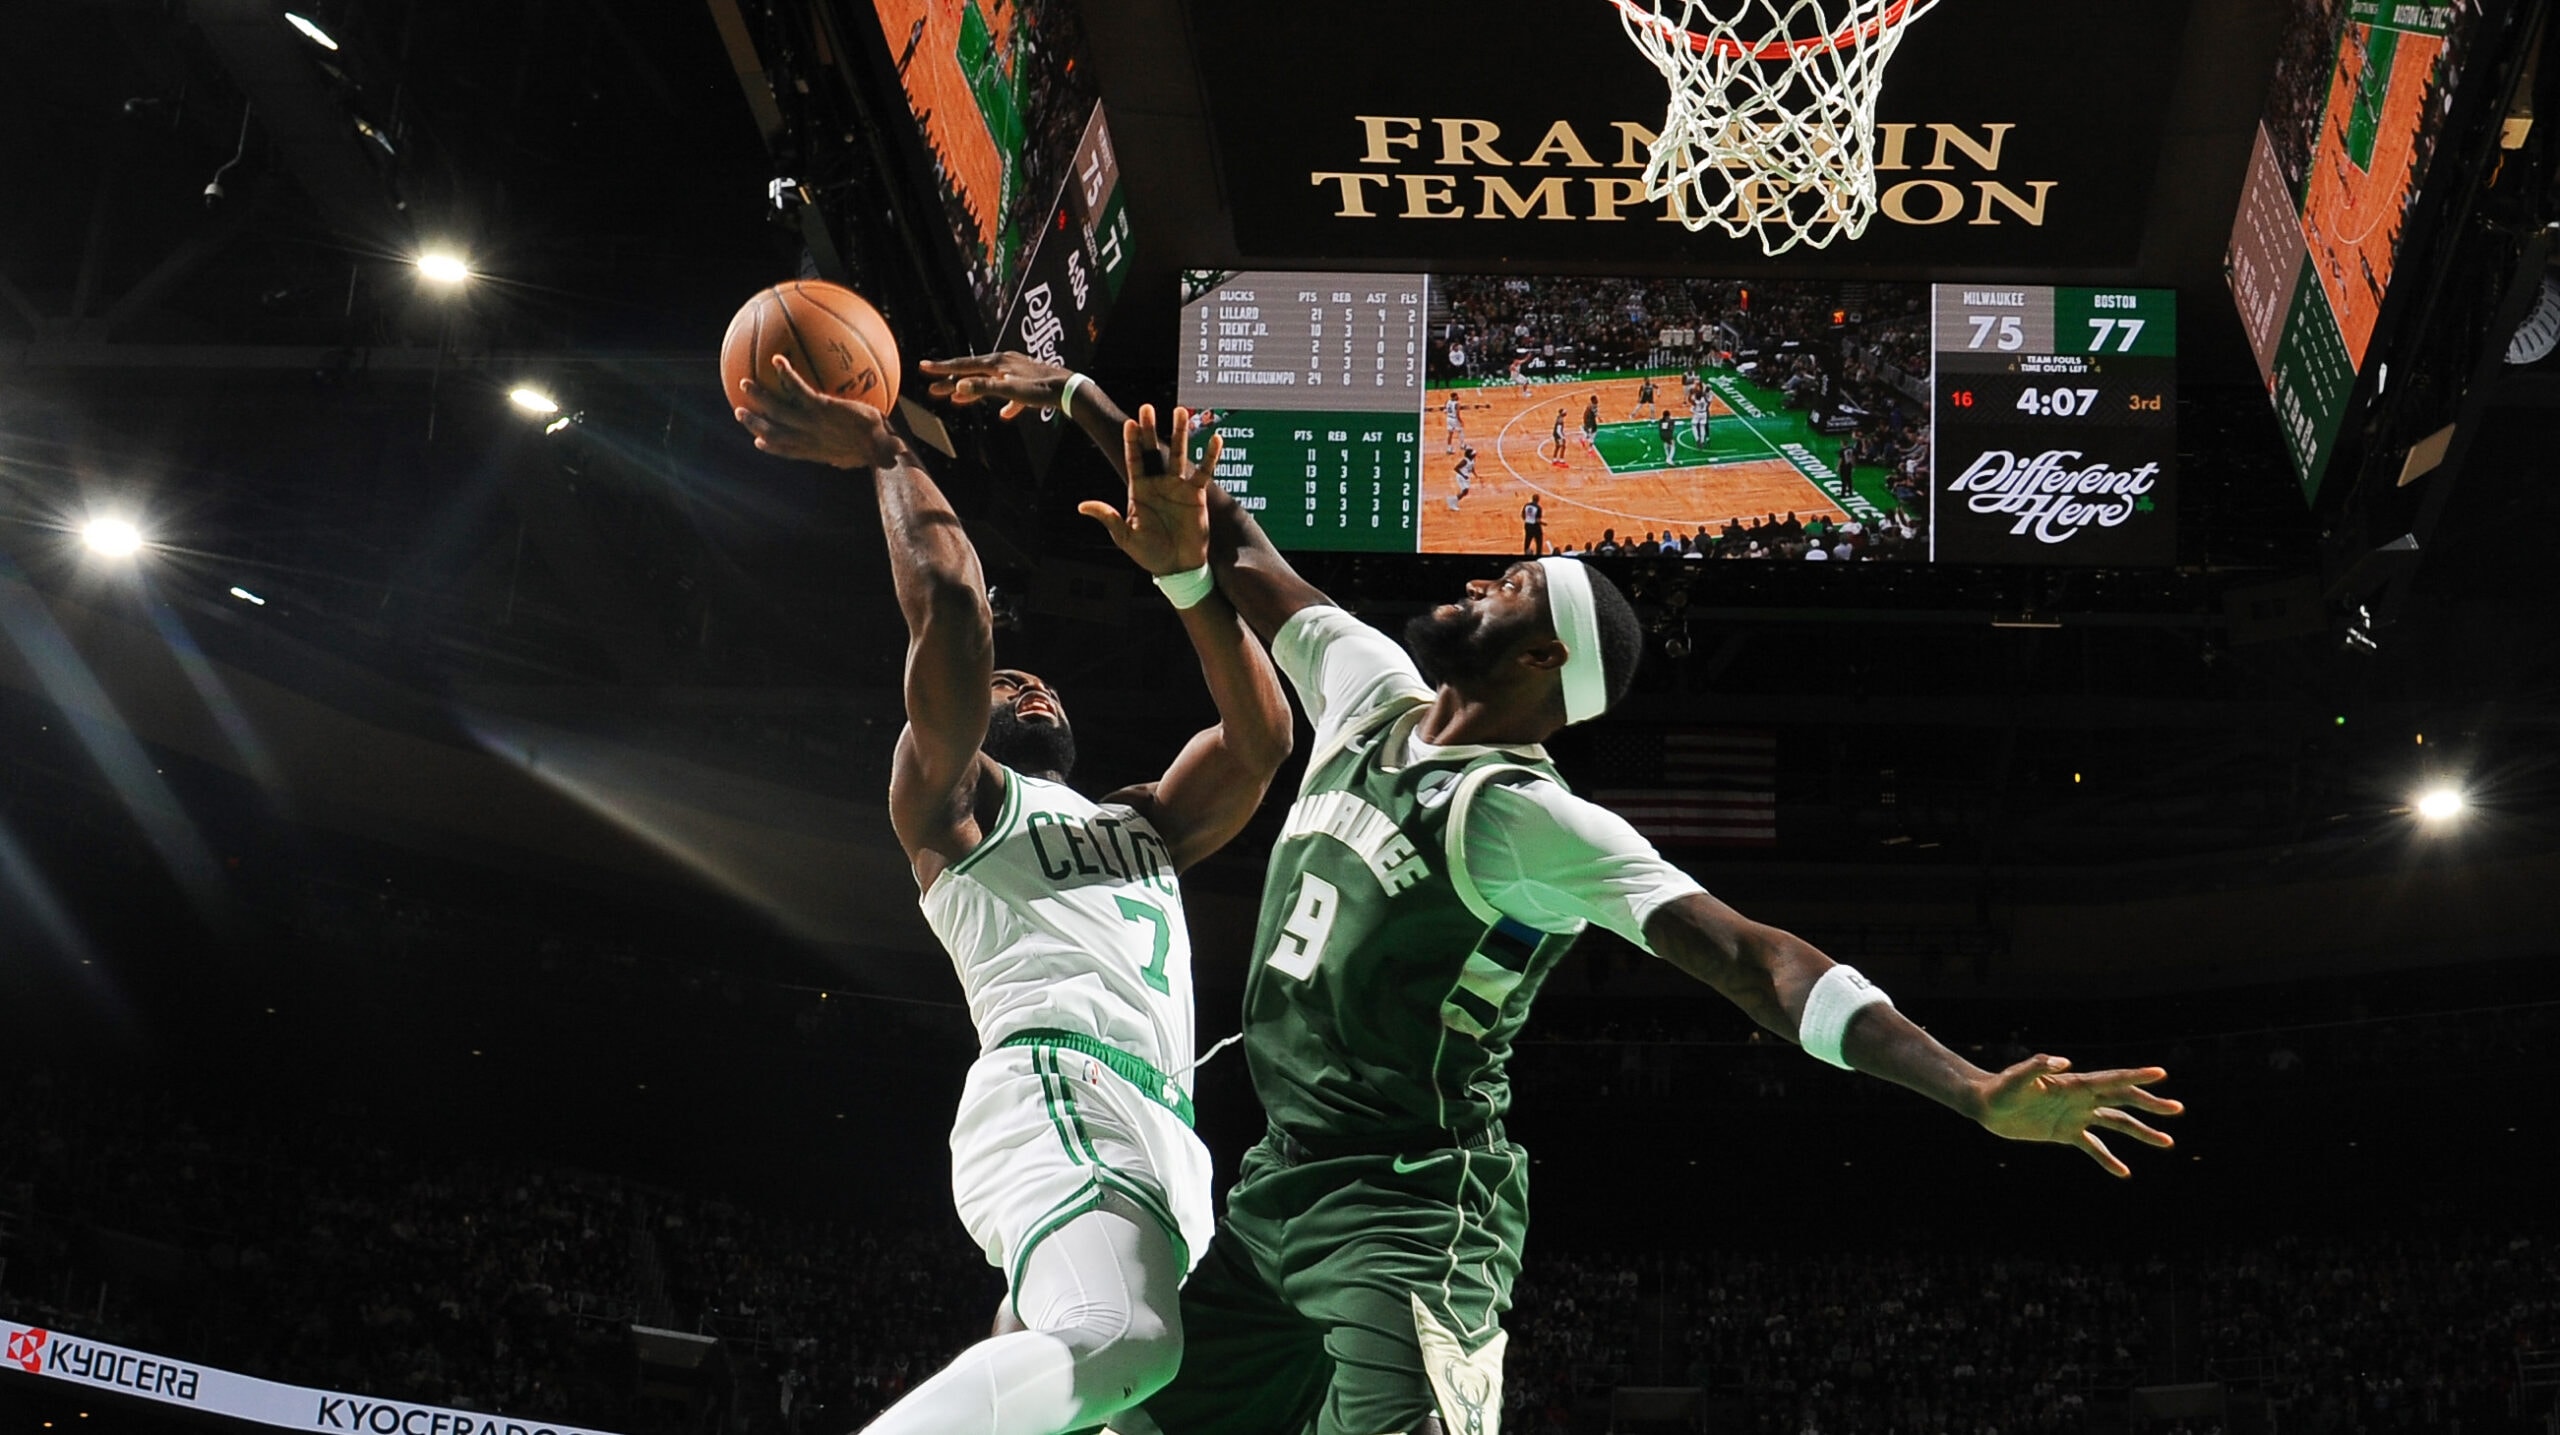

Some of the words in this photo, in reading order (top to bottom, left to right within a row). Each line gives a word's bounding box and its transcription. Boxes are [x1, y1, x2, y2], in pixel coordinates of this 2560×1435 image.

[1220, 291, 1254, 301] BUCKS
[1299, 292, 1317, 302] PTS
[1332, 293, 1351, 303] REB
[1367, 293, 1387, 303] AST
[1401, 294, 1417, 304] FLS
[1963, 292, 2024, 306] MILWAUKEE
[2094, 295, 2136, 308] BOSTON
[1202, 306, 1208, 319] 0
[1220, 307, 1259, 319] LILLARD
[1311, 308, 1322, 321] 21
[1345, 309, 1352, 321] 5
[1408, 310, 1415, 322] 2
[1201, 322, 1207, 335] 5
[1219, 322, 1250, 335] TRENT
[1252, 323, 1269, 335] JR.
[1345, 325, 1351, 337] 3
[1379, 325, 1384, 338] 1
[1409, 326, 1413, 338] 1
[1968, 316, 2023, 350] 75
[2088, 319, 2145, 351] 77
[1200, 338, 1207, 351] 9
[1218, 339, 1254, 351] PORTIS
[1312, 340, 1319, 353] 2
[1344, 340, 1351, 353] 5
[1377, 341, 1384, 354] 0
[1407, 341, 1414, 354] 0
[1198, 354, 1208, 367] 12
[1218, 354, 1253, 367] PRINCE
[1311, 356, 1318, 369] 0
[1343, 356, 1350, 369] 3
[1376, 357, 1384, 370] 0
[1407, 357, 1414, 370] 3
[2021, 364, 2041, 372] TIME
[2069, 365, 2088, 373] LEFT
[1196, 370, 1209, 383] 34
[1217, 370, 1295, 384] ANTETOKOUNMPO
[1308, 372, 1322, 385] 24
[1376, 374, 1384, 386] 6
[1406, 374, 1414, 386] 2
[1952, 391, 1974, 407] 16
[2017, 387, 2099, 416] 4:07
[2129, 395, 2161, 410] 3rd
[1215, 427, 1255, 438] CELTICS
[1294, 430, 1313, 441] PTS
[1328, 431, 1347, 441] REB
[1362, 432, 1383, 442] AST
[1397, 432, 1414, 443] FLS
[1220, 448, 1247, 461] ATUM
[1308, 448, 1316, 461] 11
[1341, 449, 1348, 462] 4
[1375, 449, 1380, 463] 1
[1404, 450, 1411, 463] 3
[1213, 464, 1254, 477] HOLIDAY
[1306, 465, 1317, 478] 13
[1341, 465, 1348, 478] 3
[1373, 466, 1380, 479] 3
[1405, 466, 1409, 480] 1
[1948, 450, 2160, 508] Different
[1306, 481, 1317, 494] 19
[1340, 482, 1347, 495] 6
[1373, 482, 1380, 495] 3
[1403, 483, 1410, 496] 2
[1306, 497, 1316, 510] 19
[1340, 498, 1347, 511] 3
[1372, 499, 1379, 512] 3
[1402, 499, 1409, 512] 0
[1306, 513, 1313, 526] 0
[1340, 514, 1347, 527] 3
[1372, 515, 1379, 528] 0
[1402, 515, 1409, 528] 2
[1996, 494, 2133, 543] Here
[1281, 790, 1431, 897] ILWAUKEE
[1027, 811, 1182, 908] CELTIC
[1266, 871, 1340, 981] 9
[1112, 894, 1171, 997] 7
[48, 1340, 199, 1400] KYOCERA
